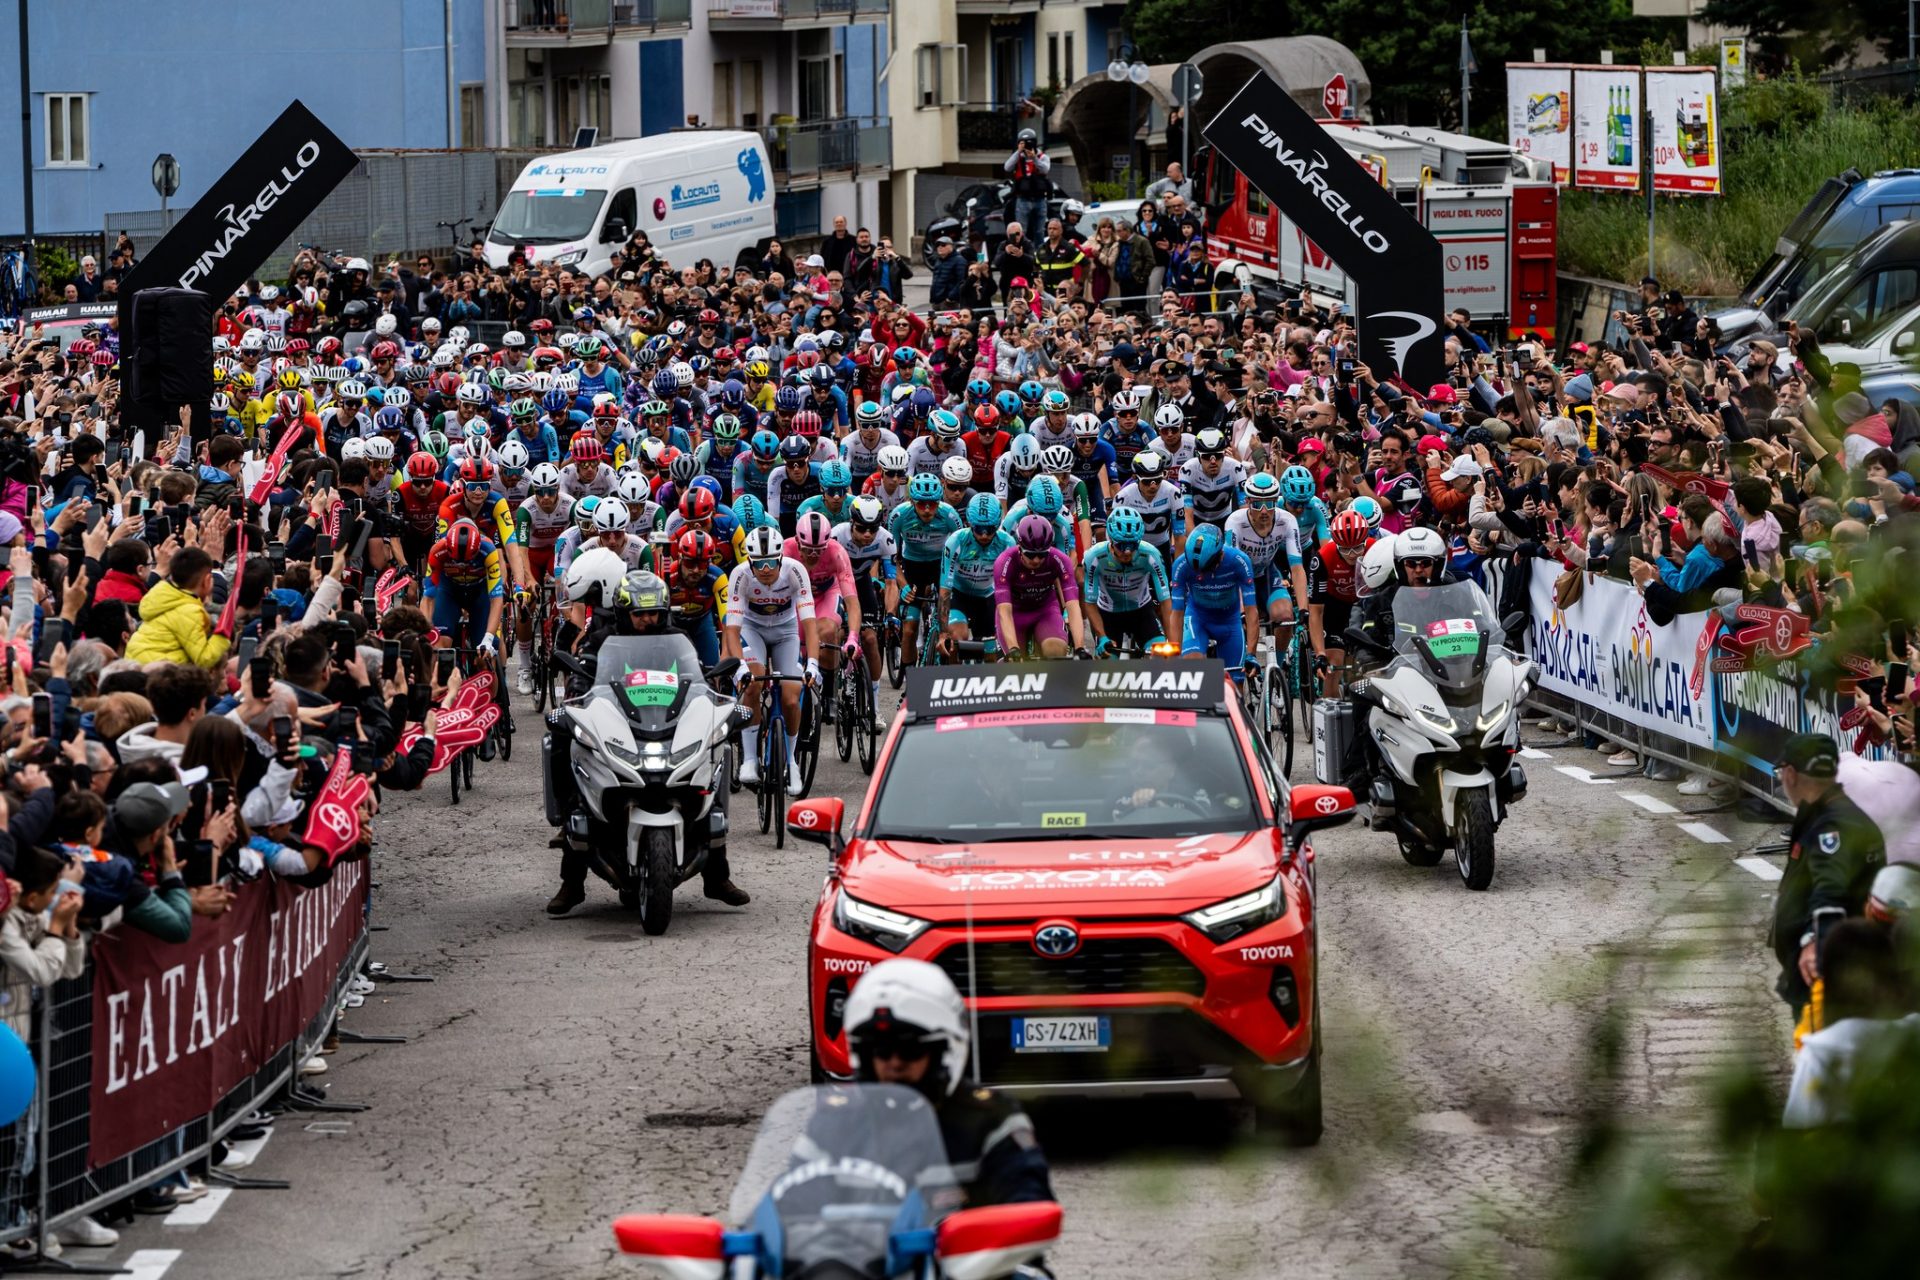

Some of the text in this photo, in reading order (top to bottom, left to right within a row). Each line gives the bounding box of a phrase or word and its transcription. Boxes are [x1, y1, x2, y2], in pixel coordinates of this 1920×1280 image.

[545, 166, 607, 176] LOCAUTO
[682, 183, 720, 200] LOCAUTO
[1240, 113, 1389, 254] PINARELLO
[178, 140, 320, 291] PINARELLO
[1433, 208, 1503, 219] VIGILI DEL FUOCO
[1255, 220, 1266, 237] 115
[1465, 254, 1490, 271] 115
[332, 506, 342, 539] TOYOTA
[1741, 608, 1772, 619] TOYOTA
[1440, 636, 1478, 645] PRODUCTION
[1530, 614, 1600, 695] BASILICATA
[1714, 660, 1746, 670] TOYOTA
[637, 688, 677, 696] PRODUCTION
[930, 671, 1205, 699] IUMAN IUMAN
[1612, 643, 1694, 728] BASILICATA
[929, 691, 1199, 708] intimissimi uomo intimissimi uomo
[437, 711, 469, 727] OYOTA
[978, 712, 1050, 723] DIREZIONE
[1053, 711, 1101, 720] CORSA
[1047, 816, 1081, 826] RACE
[1068, 847, 1208, 861] KINTO
[949, 880, 1166, 891] OFFICIAL MOBILITY PARTNER
[952, 869, 1166, 887] TOYOTA
[1240, 945, 1294, 961] TOYOTA
[823, 958, 872, 973] TOYOTA
[105, 931, 247, 1095] EATALY
